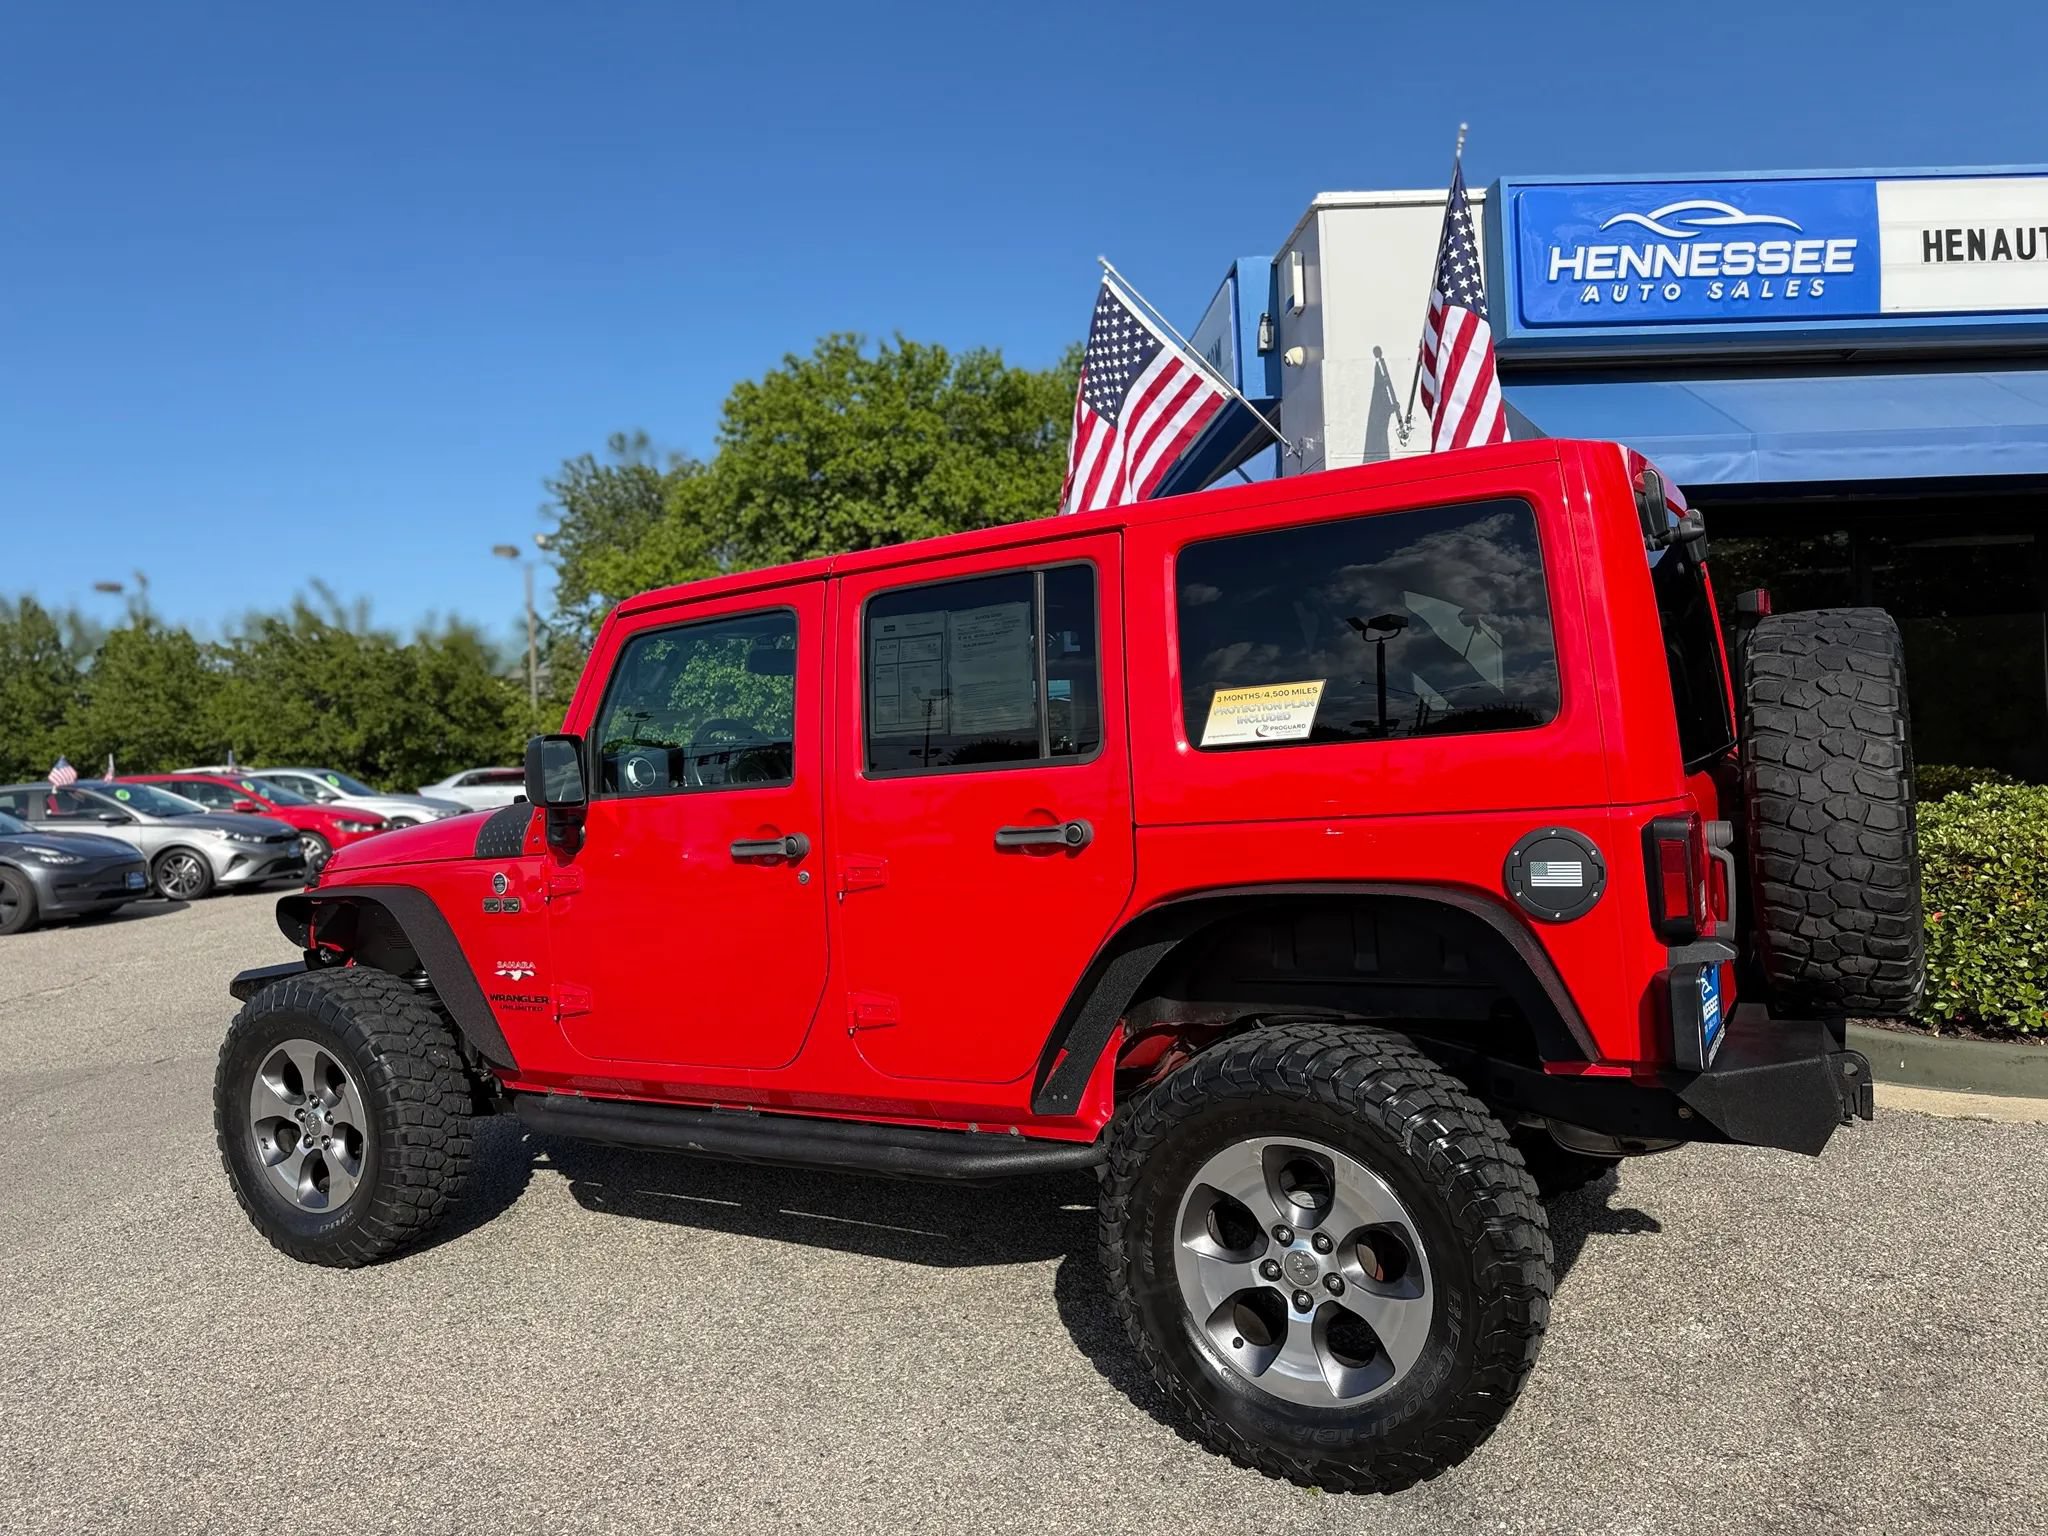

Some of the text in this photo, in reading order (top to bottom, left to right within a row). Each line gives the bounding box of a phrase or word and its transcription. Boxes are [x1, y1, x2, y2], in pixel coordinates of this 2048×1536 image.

[1549, 239, 1857, 281] HENNESSEE
[1581, 278, 1825, 304] AUTO SALES
[1291, 686, 1318, 696] MILES
[1214, 703, 1282, 716] PROTECTION
[1237, 712, 1291, 725] INCLUDED
[490, 994, 549, 1004] WRANGLER
[500, 1004, 543, 1012] UNLIMITED
